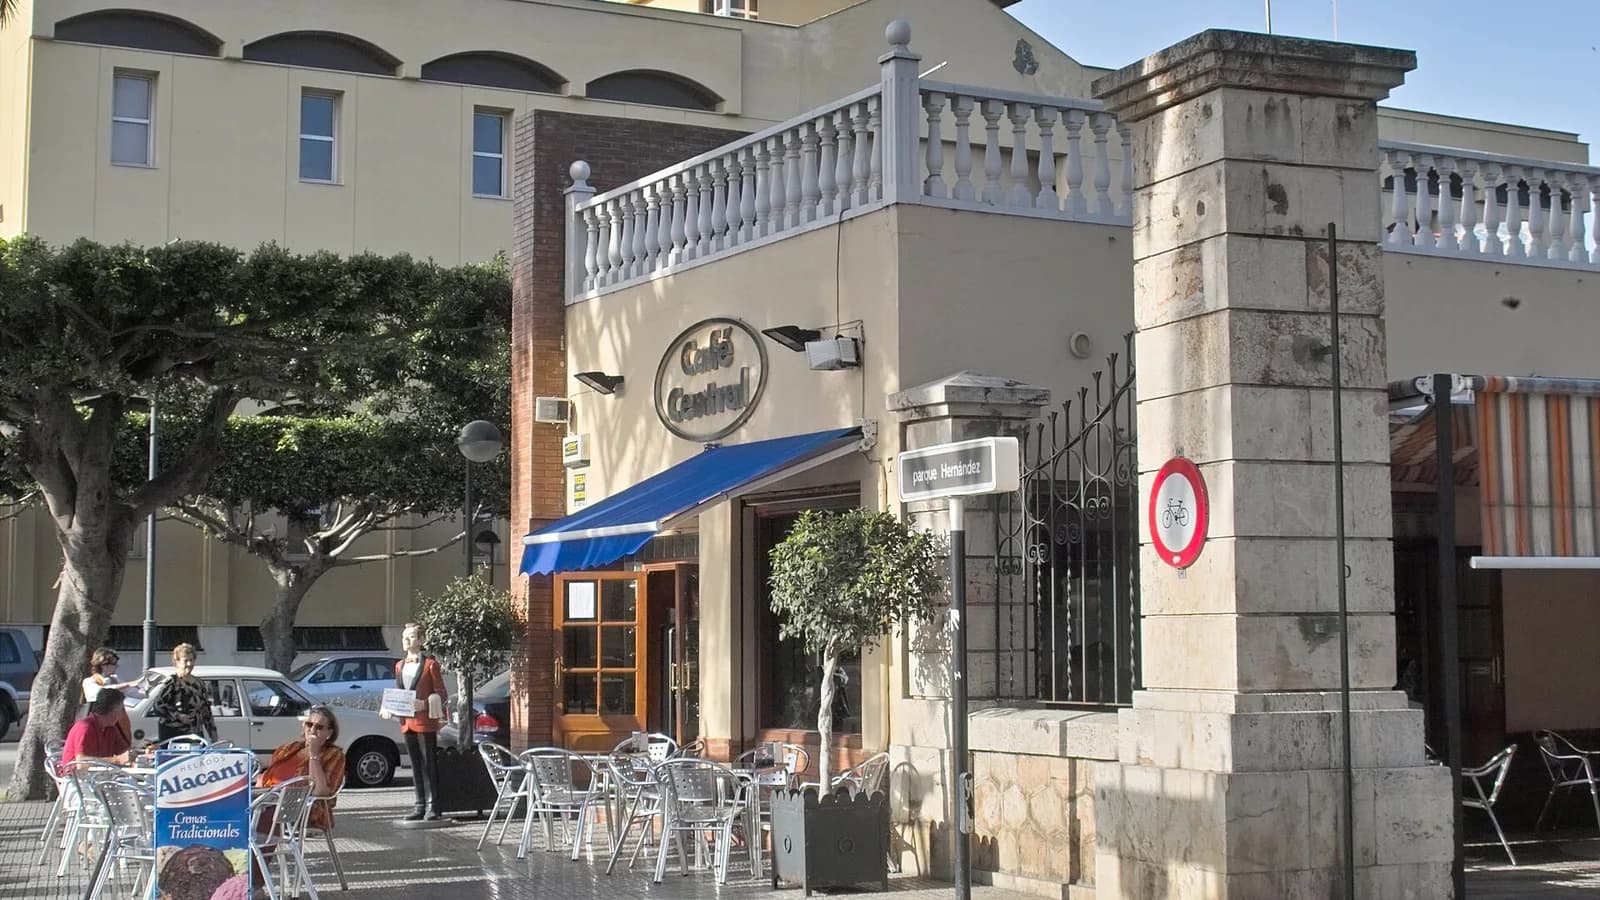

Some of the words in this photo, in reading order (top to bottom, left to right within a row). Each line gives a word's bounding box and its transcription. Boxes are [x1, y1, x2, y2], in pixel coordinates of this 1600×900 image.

[680, 326, 735, 376] Café
[667, 366, 750, 423] Central
[912, 467, 938, 487] parque
[940, 459, 981, 479] Hernández
[158, 759, 246, 797] Alacant
[180, 755, 226, 771] HELADOS
[168, 823, 240, 840] Tradicionales
